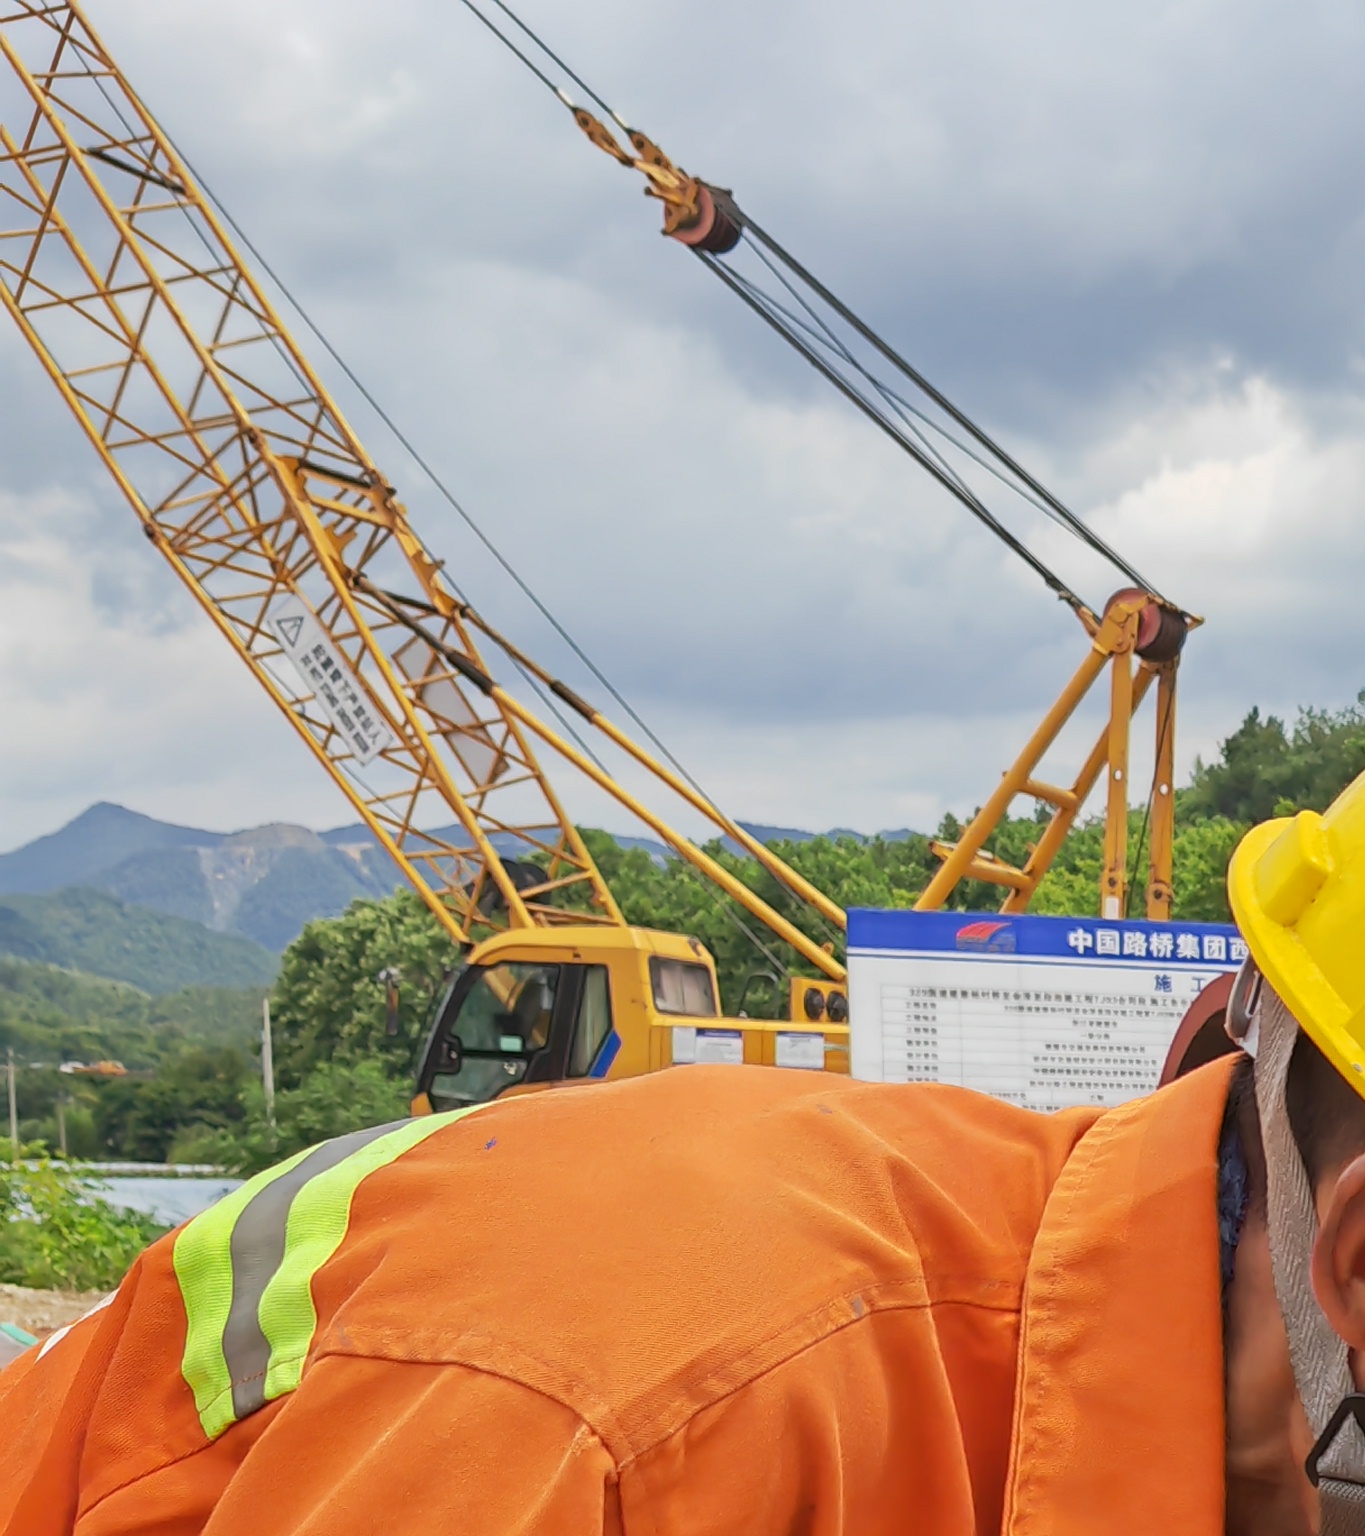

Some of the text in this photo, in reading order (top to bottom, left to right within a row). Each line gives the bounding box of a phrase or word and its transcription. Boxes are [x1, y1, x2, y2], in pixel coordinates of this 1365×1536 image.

[1068, 927, 1248, 962] 中国路桥集团西
